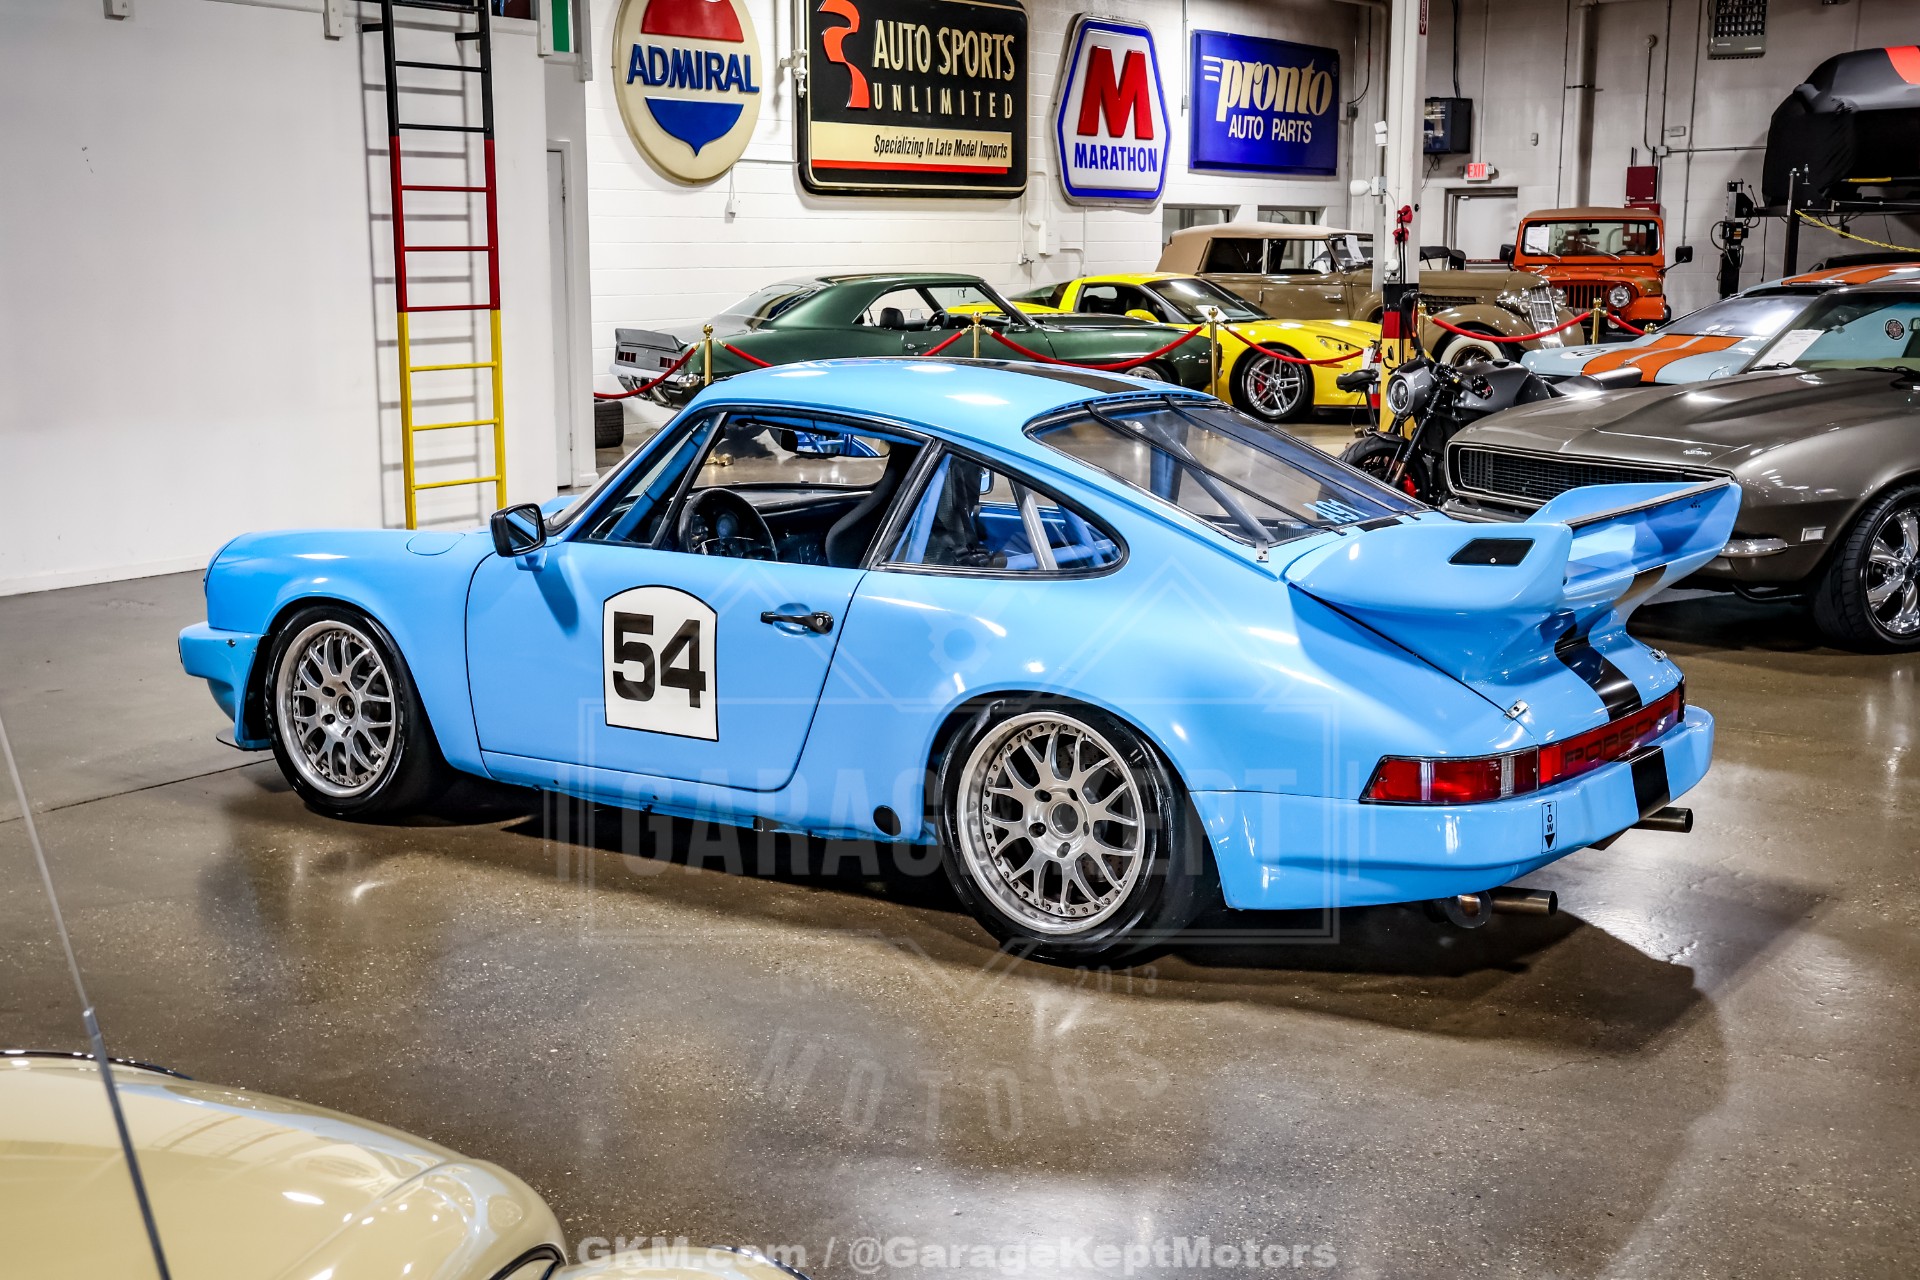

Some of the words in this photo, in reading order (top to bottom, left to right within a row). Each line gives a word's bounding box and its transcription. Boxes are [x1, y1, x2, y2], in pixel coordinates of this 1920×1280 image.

[626, 43, 760, 93] ADMIRAL
[872, 19, 931, 73] AUTO
[938, 26, 1015, 82] SPORTS
[873, 82, 1013, 119] UNLIMITED
[1077, 44, 1154, 140] M
[1215, 59, 1333, 122] pronto
[873, 134, 924, 158] Specializing
[925, 137, 933, 155] In
[935, 138, 952, 156] Late
[953, 139, 978, 157] Model
[979, 141, 1008, 160] Imports
[1228, 114, 1264, 140] AUTO
[1271, 118, 1313, 144] PARTS
[1074, 142, 1158, 172] MARATHON
[1467, 163, 1486, 178] EXIT
[612, 611, 706, 708] 54
[1546, 803, 1554, 833] TOW
